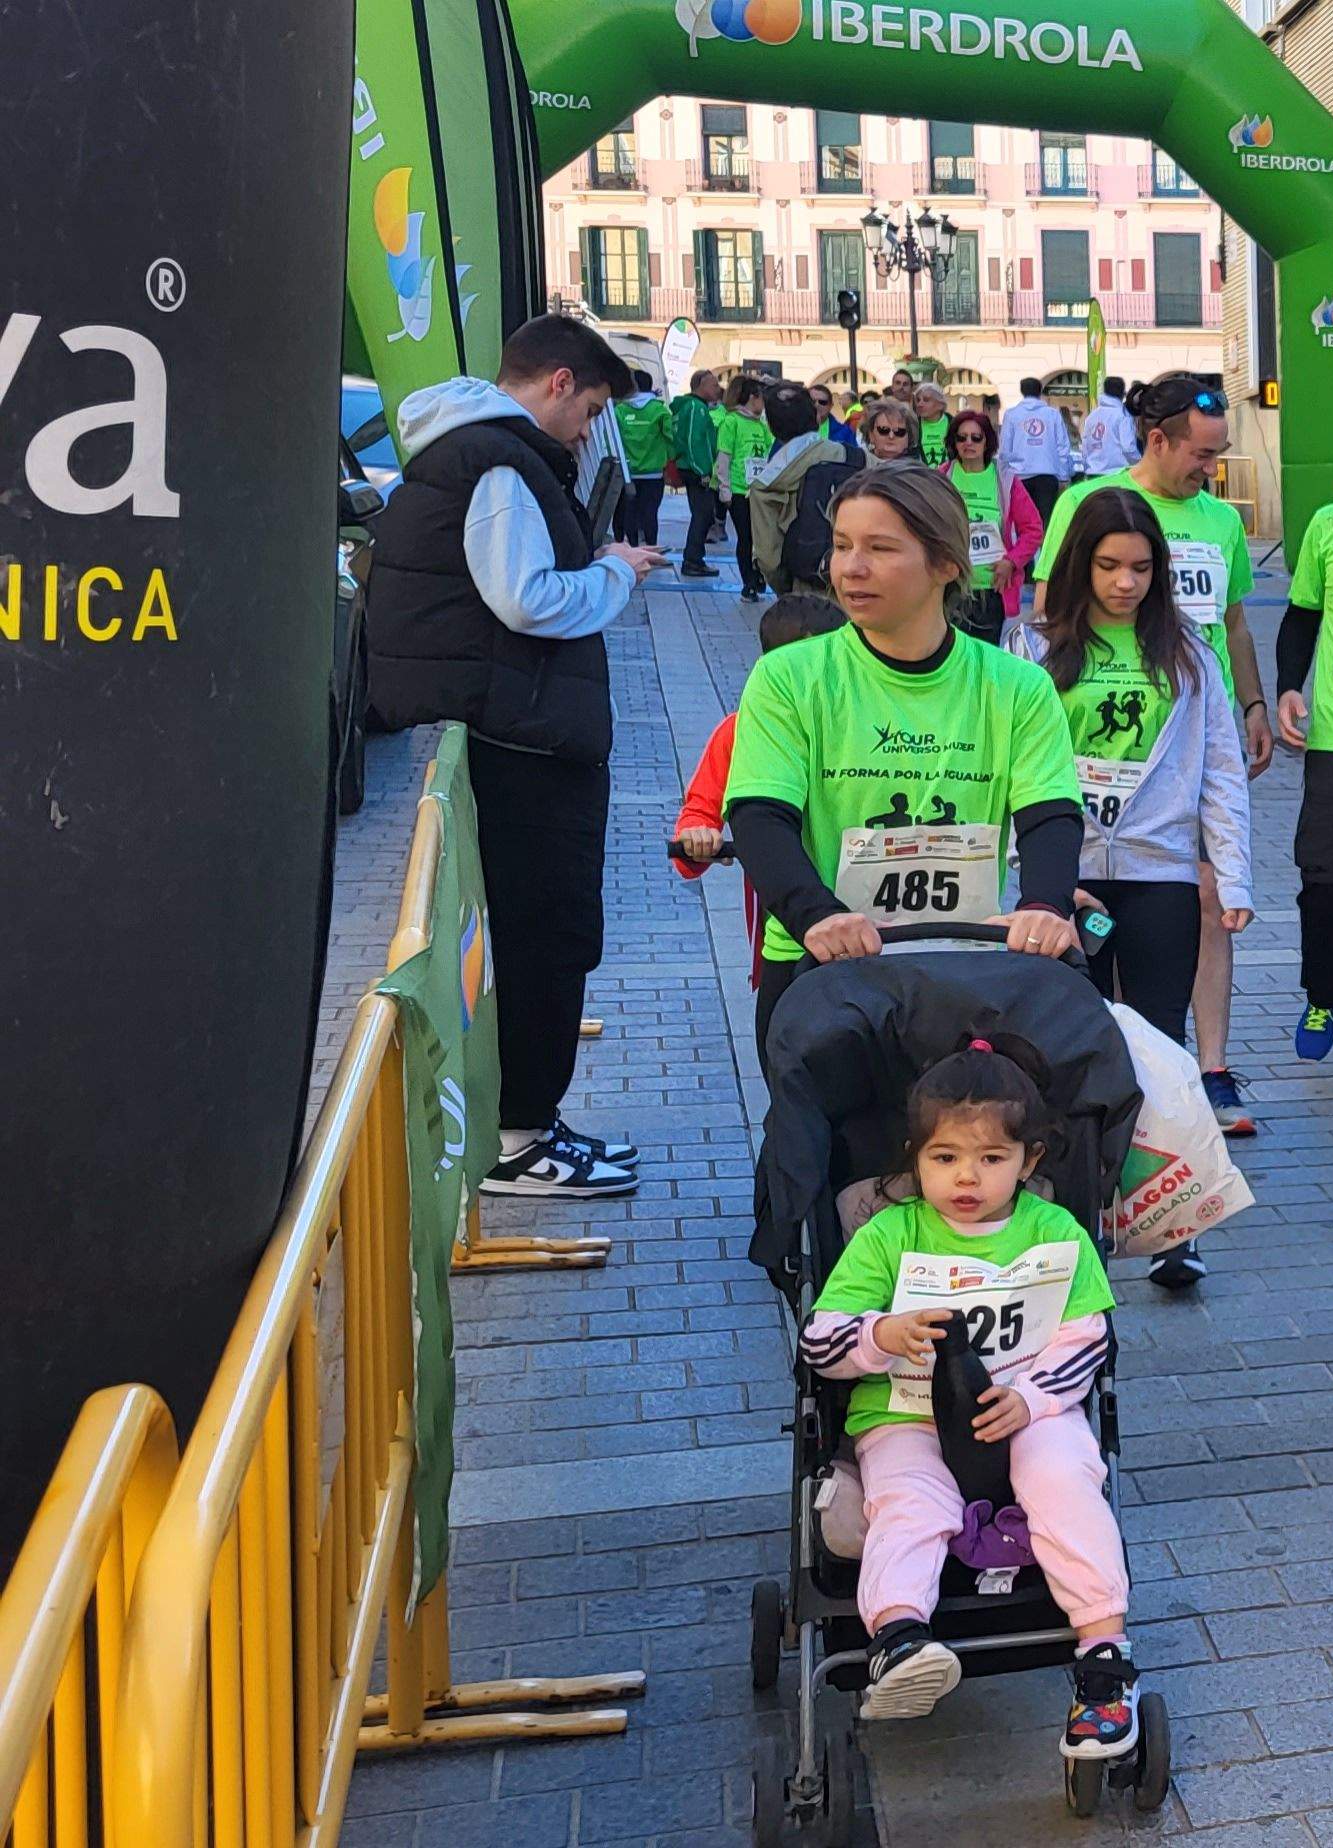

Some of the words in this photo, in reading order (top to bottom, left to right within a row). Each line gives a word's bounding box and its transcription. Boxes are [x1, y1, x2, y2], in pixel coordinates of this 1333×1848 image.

[811, 0, 1144, 72] IBERDROLA
[882, 743, 941, 755] UNIVERSO
[839, 767, 890, 780] FORMA
[894, 768, 922, 781] POR
[872, 870, 960, 913] 485
